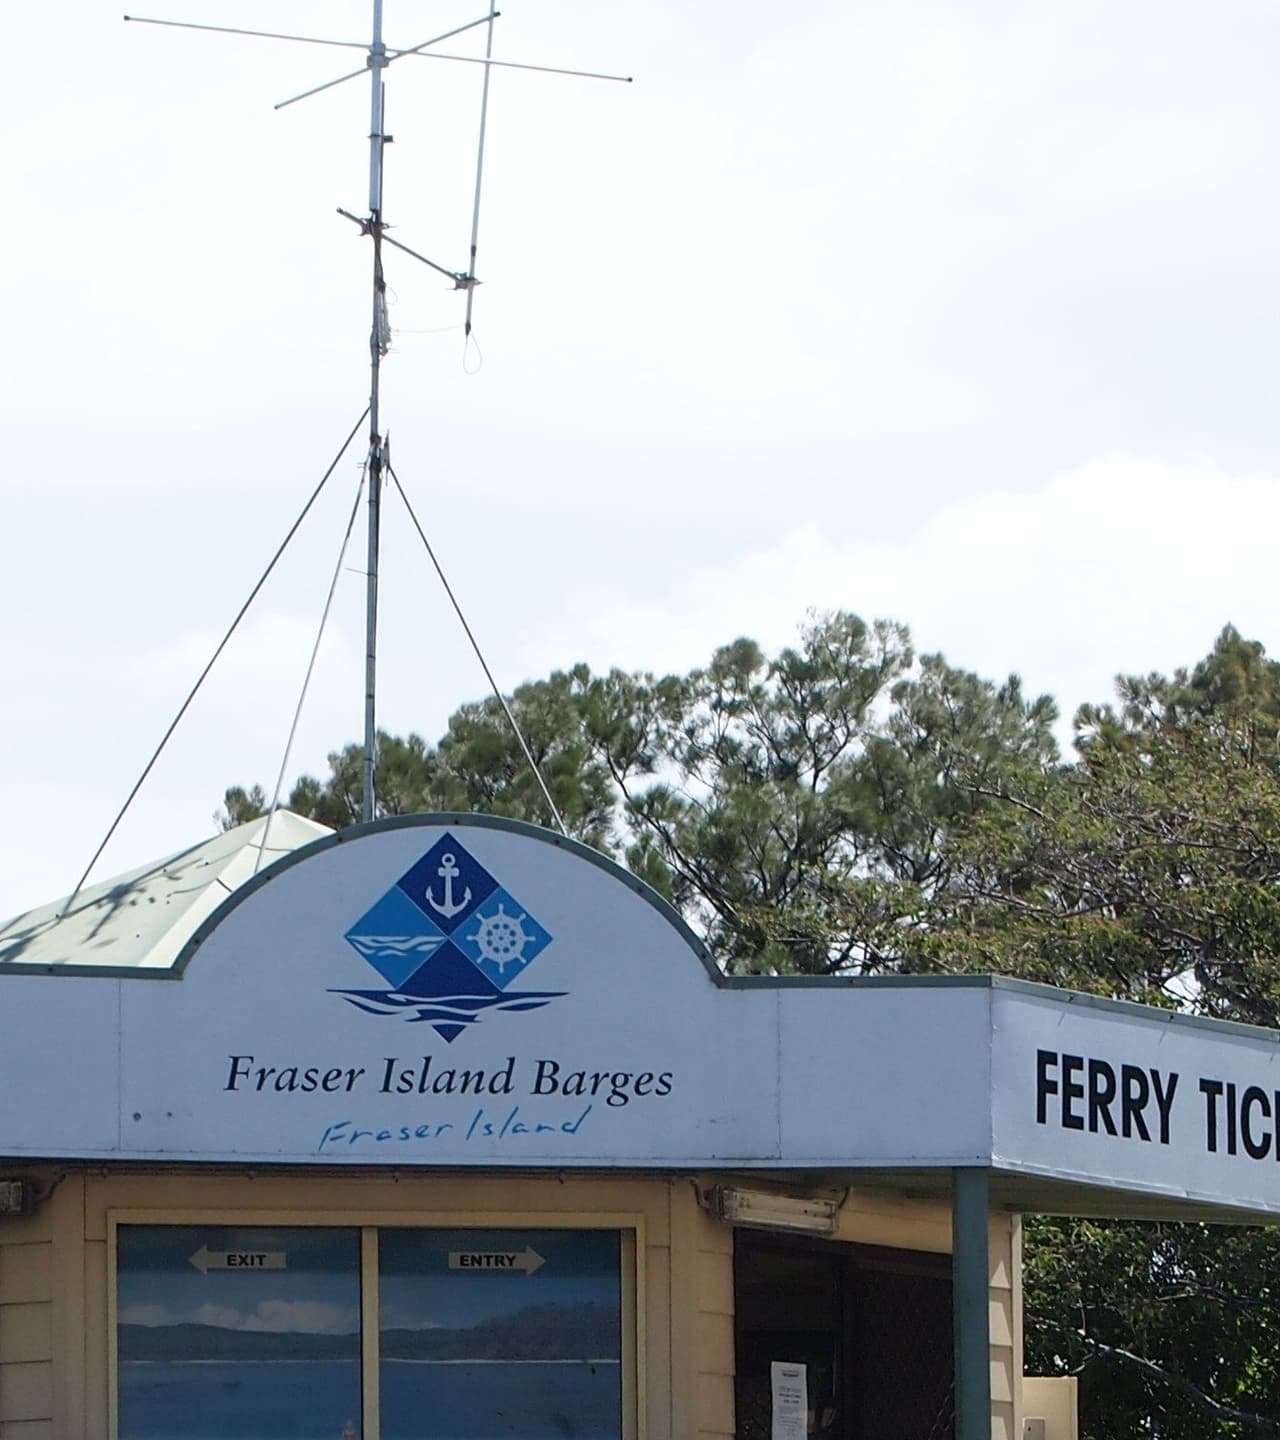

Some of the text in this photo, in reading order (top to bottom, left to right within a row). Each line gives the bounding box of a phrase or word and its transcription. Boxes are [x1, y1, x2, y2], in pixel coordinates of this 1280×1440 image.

[223, 1055, 674, 1107] Fraser Island Barges
[1036, 1048, 1179, 1145] FERRY
[318, 1105, 593, 1152] Fraser Island
[227, 1254, 266, 1267] EXIT
[459, 1254, 517, 1267] ENTRY
